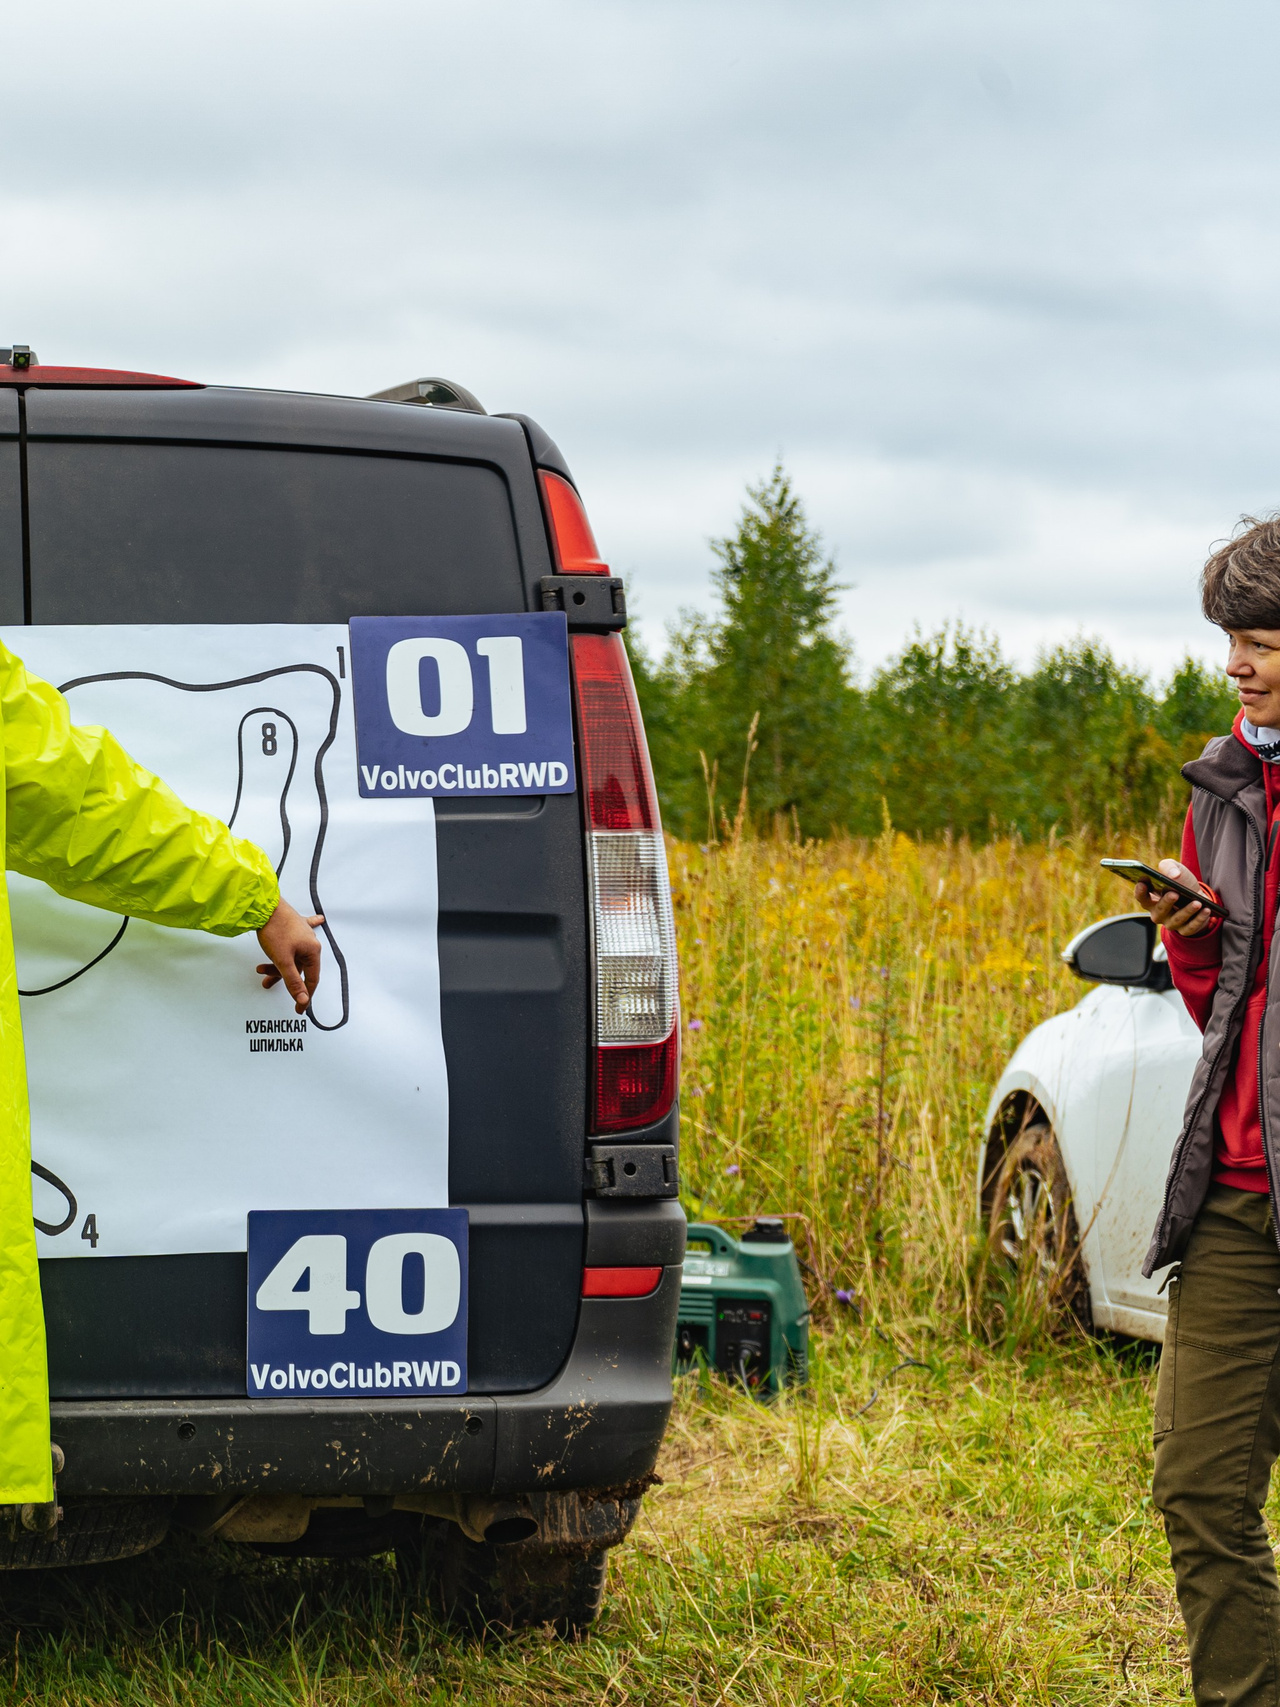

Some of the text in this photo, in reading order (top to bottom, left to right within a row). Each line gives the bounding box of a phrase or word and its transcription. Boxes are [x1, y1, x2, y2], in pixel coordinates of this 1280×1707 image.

[336, 646, 346, 679] 1
[386, 636, 528, 737] 01
[261, 722, 278, 757] 8
[361, 761, 569, 791] VolvoClubRWD
[245, 1019, 307, 1034] КУБАНСКАЯ
[249, 1038, 304, 1052] ШПИЛЬКА
[81, 1213, 99, 1248] 4
[256, 1232, 461, 1335] 40
[250, 1360, 461, 1390] VolvoClubRWD
